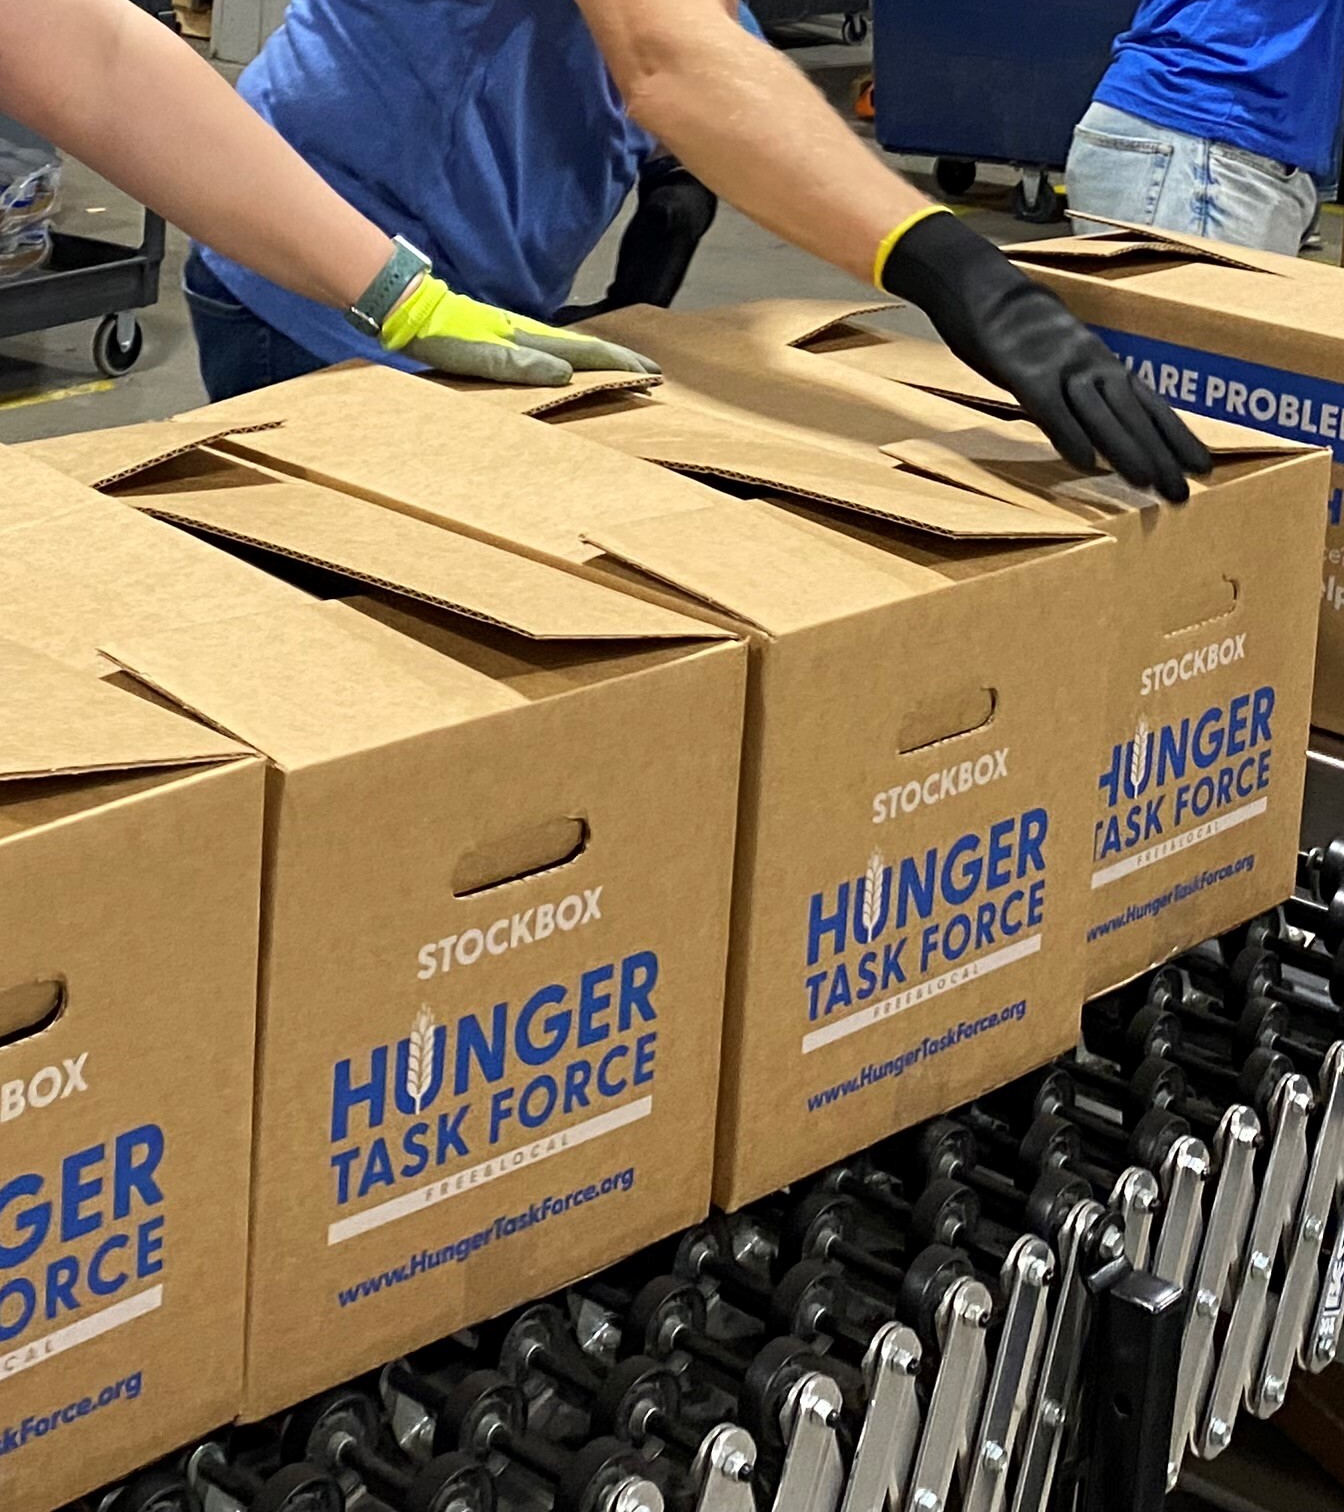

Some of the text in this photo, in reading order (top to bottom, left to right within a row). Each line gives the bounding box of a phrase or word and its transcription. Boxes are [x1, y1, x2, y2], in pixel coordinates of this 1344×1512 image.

[1140, 633, 1247, 696] STOCKBOX
[872, 748, 1009, 823] STOCKBOX
[1094, 749, 1271, 861] TASK FORCE
[1098, 685, 1275, 808] HUNGER
[417, 885, 604, 980] STOCKBOX
[806, 806, 1049, 966] HUNGER
[1086, 854, 1255, 942] www.HungerTaskForce.org
[805, 879, 1045, 1021] TASK FORCE
[330, 950, 659, 1144] HUNGER
[806, 998, 1027, 1113] www.HungerTaskForce.org
[330, 1031, 657, 1206] TASK FORCE
[338, 1166, 635, 1308] www.HungerTaskForce.org
